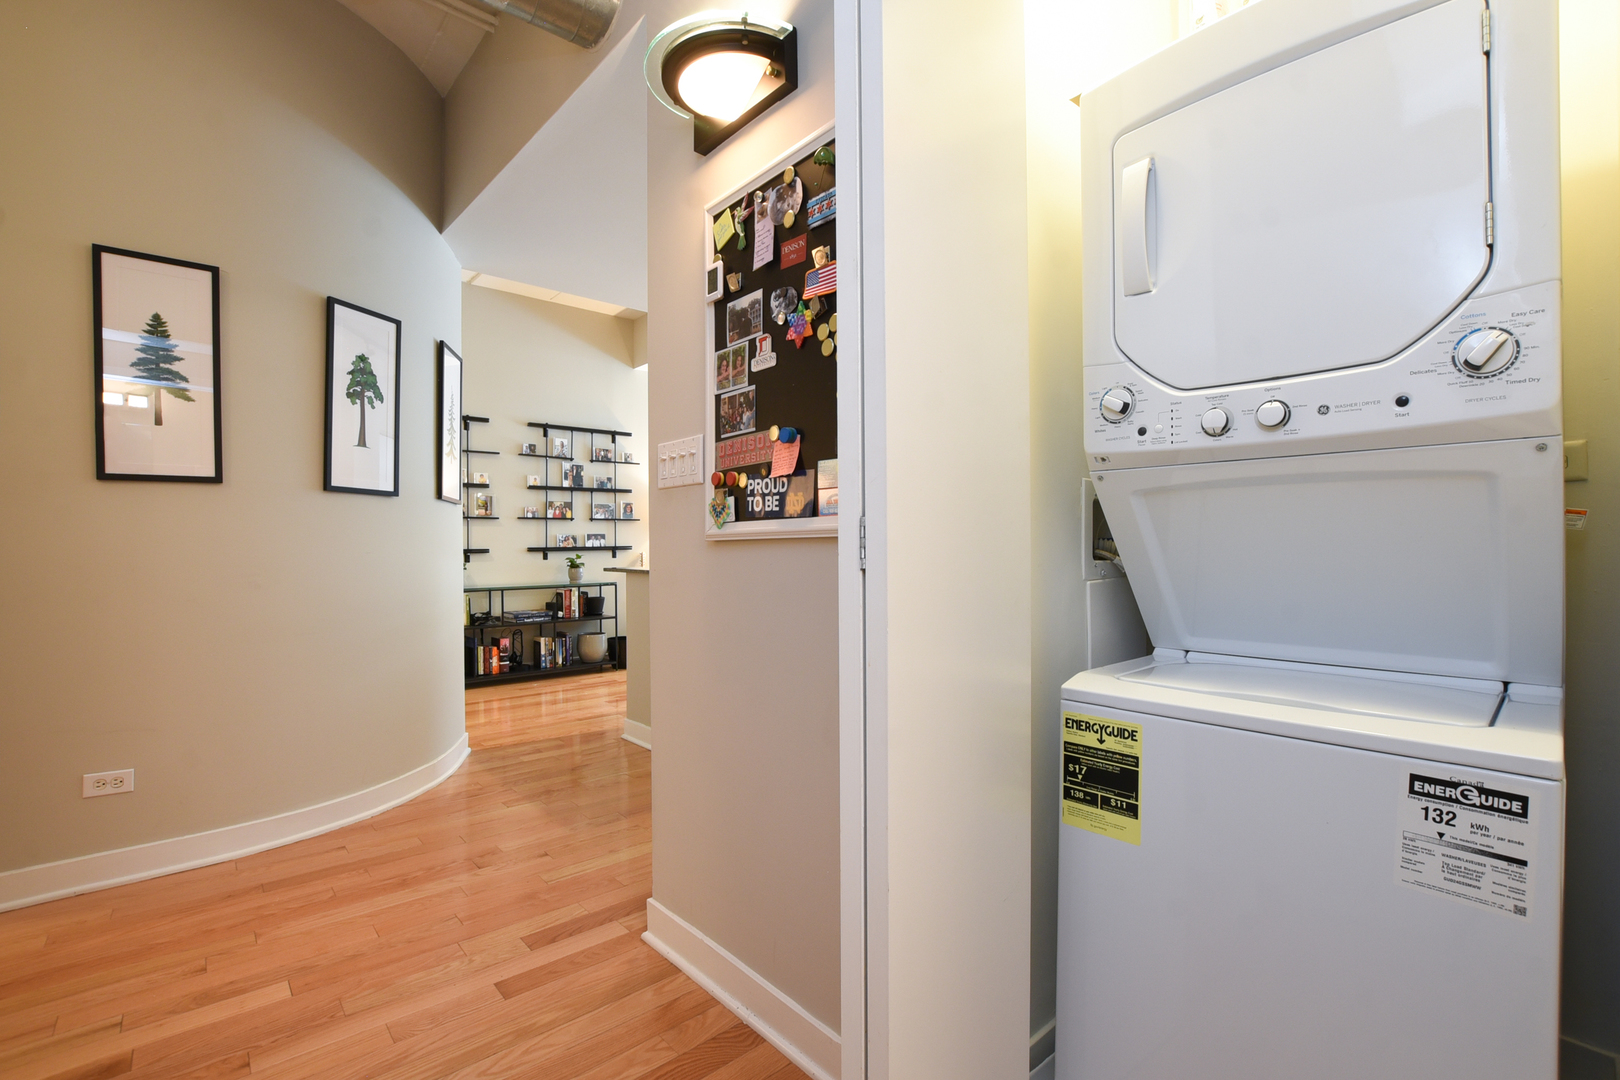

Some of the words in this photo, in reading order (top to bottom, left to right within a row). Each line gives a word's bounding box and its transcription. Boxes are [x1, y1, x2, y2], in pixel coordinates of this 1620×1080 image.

[782, 239, 805, 254] DENISON
[1460, 312, 1487, 320] Cottons
[720, 449, 774, 469] UNIVERSITY
[747, 477, 788, 494] PROUD
[747, 496, 762, 512] TO
[765, 495, 780, 511] BE
[1065, 717, 1138, 743] ENERGYGUIDE
[1068, 764, 1087, 775] $17
[1070, 789, 1084, 799] 138
[1414, 781, 1523, 813] ENERGUIDE
[1110, 798, 1126, 809] $11
[1424, 799, 1454, 808] consumption
[1459, 806, 1496, 817] Consommation
[1420, 806, 1457, 828] 132
[1470, 822, 1490, 833] kWh
